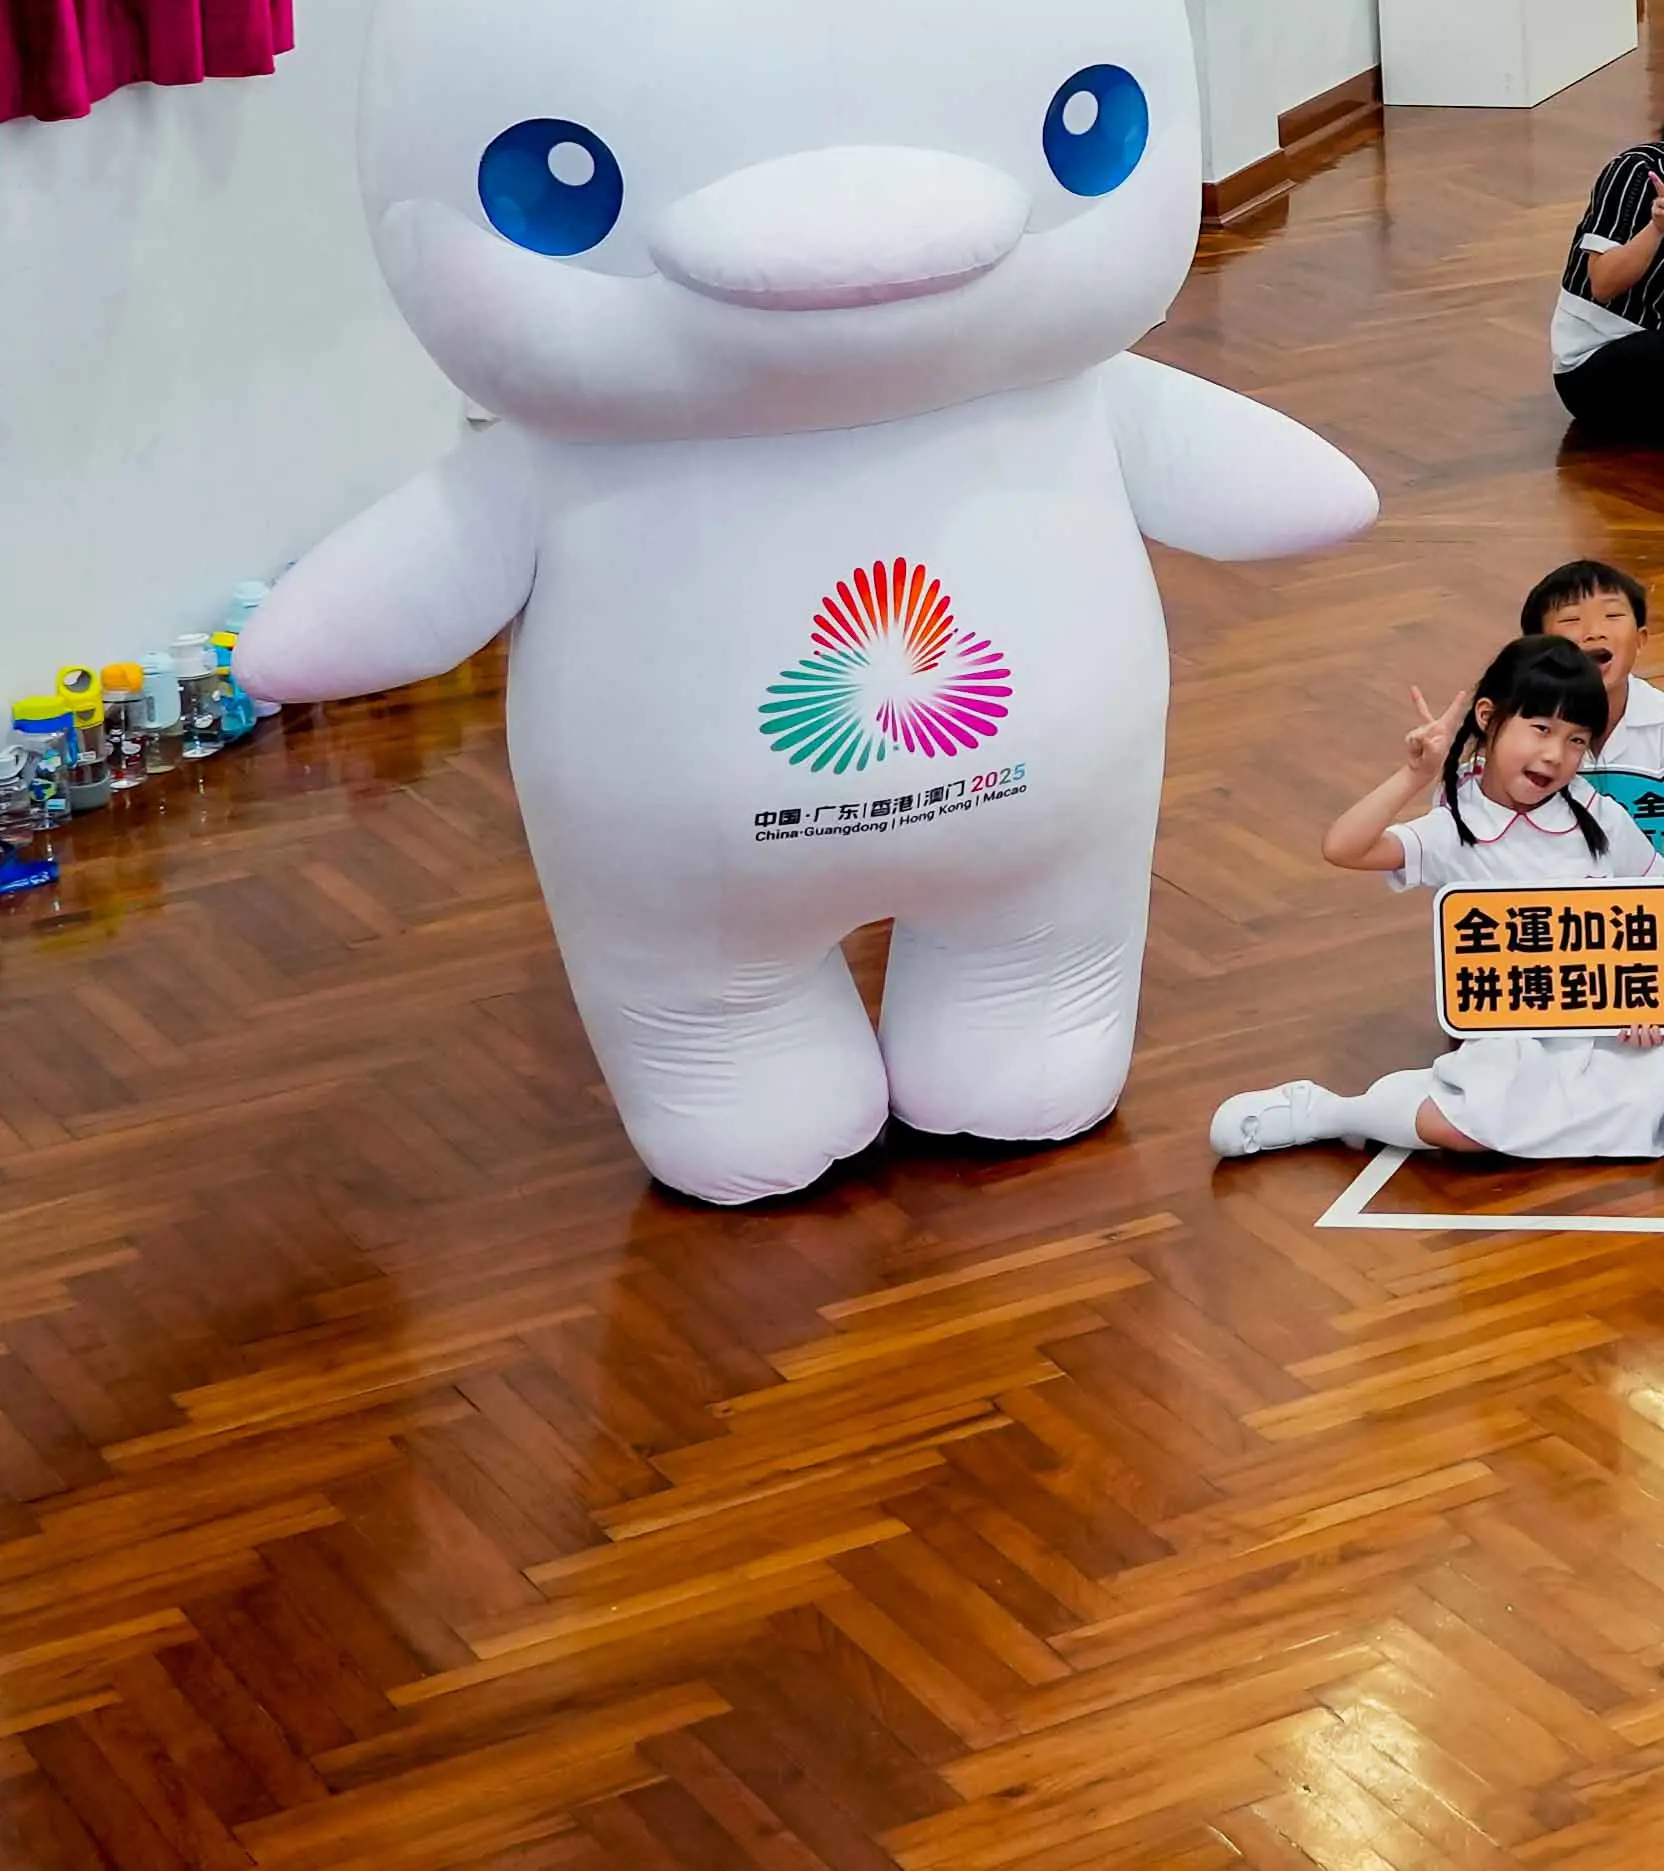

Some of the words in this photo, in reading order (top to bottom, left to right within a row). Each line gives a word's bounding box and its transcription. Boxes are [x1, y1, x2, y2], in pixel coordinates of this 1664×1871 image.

[970, 762, 1027, 793] 2025
[899, 810, 936, 827] Hong
[938, 799, 973, 816] Kong
[982, 783, 1028, 803] Macao
[1453, 905, 1658, 954] 全運加油
